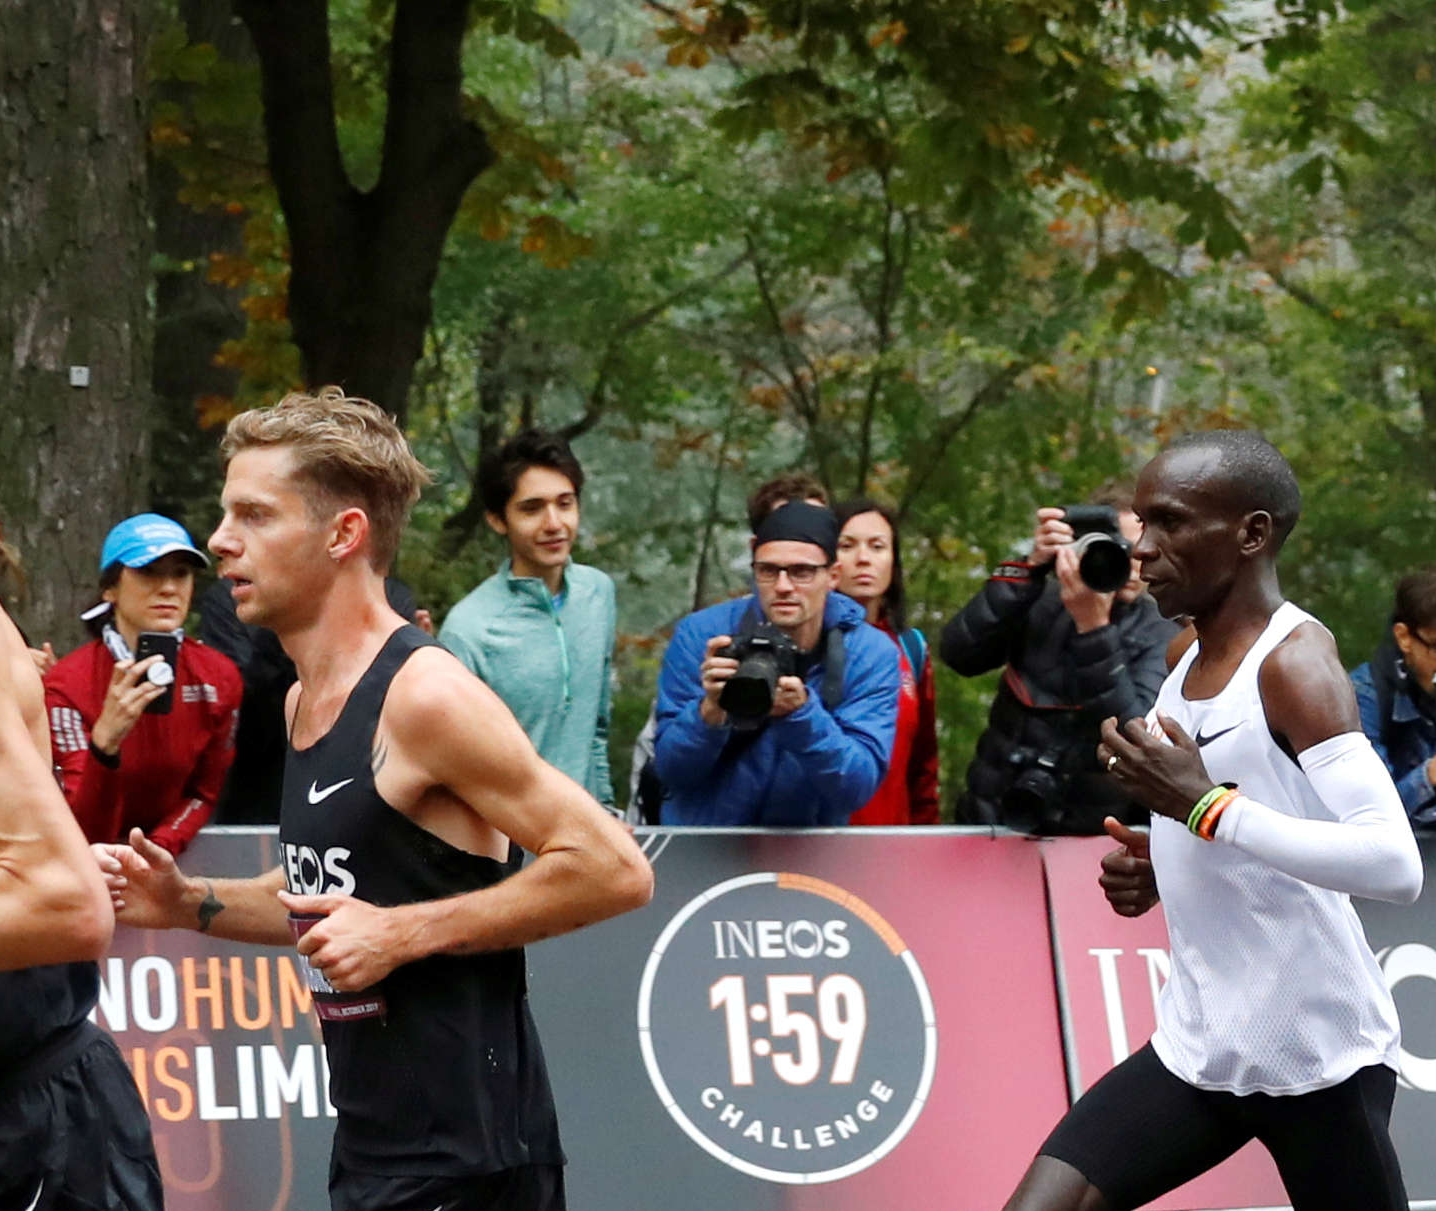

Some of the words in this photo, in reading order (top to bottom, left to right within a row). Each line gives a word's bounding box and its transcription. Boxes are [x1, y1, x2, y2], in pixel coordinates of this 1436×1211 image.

[281, 843, 357, 897] EOS
[712, 919, 851, 959] INEOS
[708, 973, 867, 1087] 1:59
[701, 1079, 894, 1150] CHALLENGE
